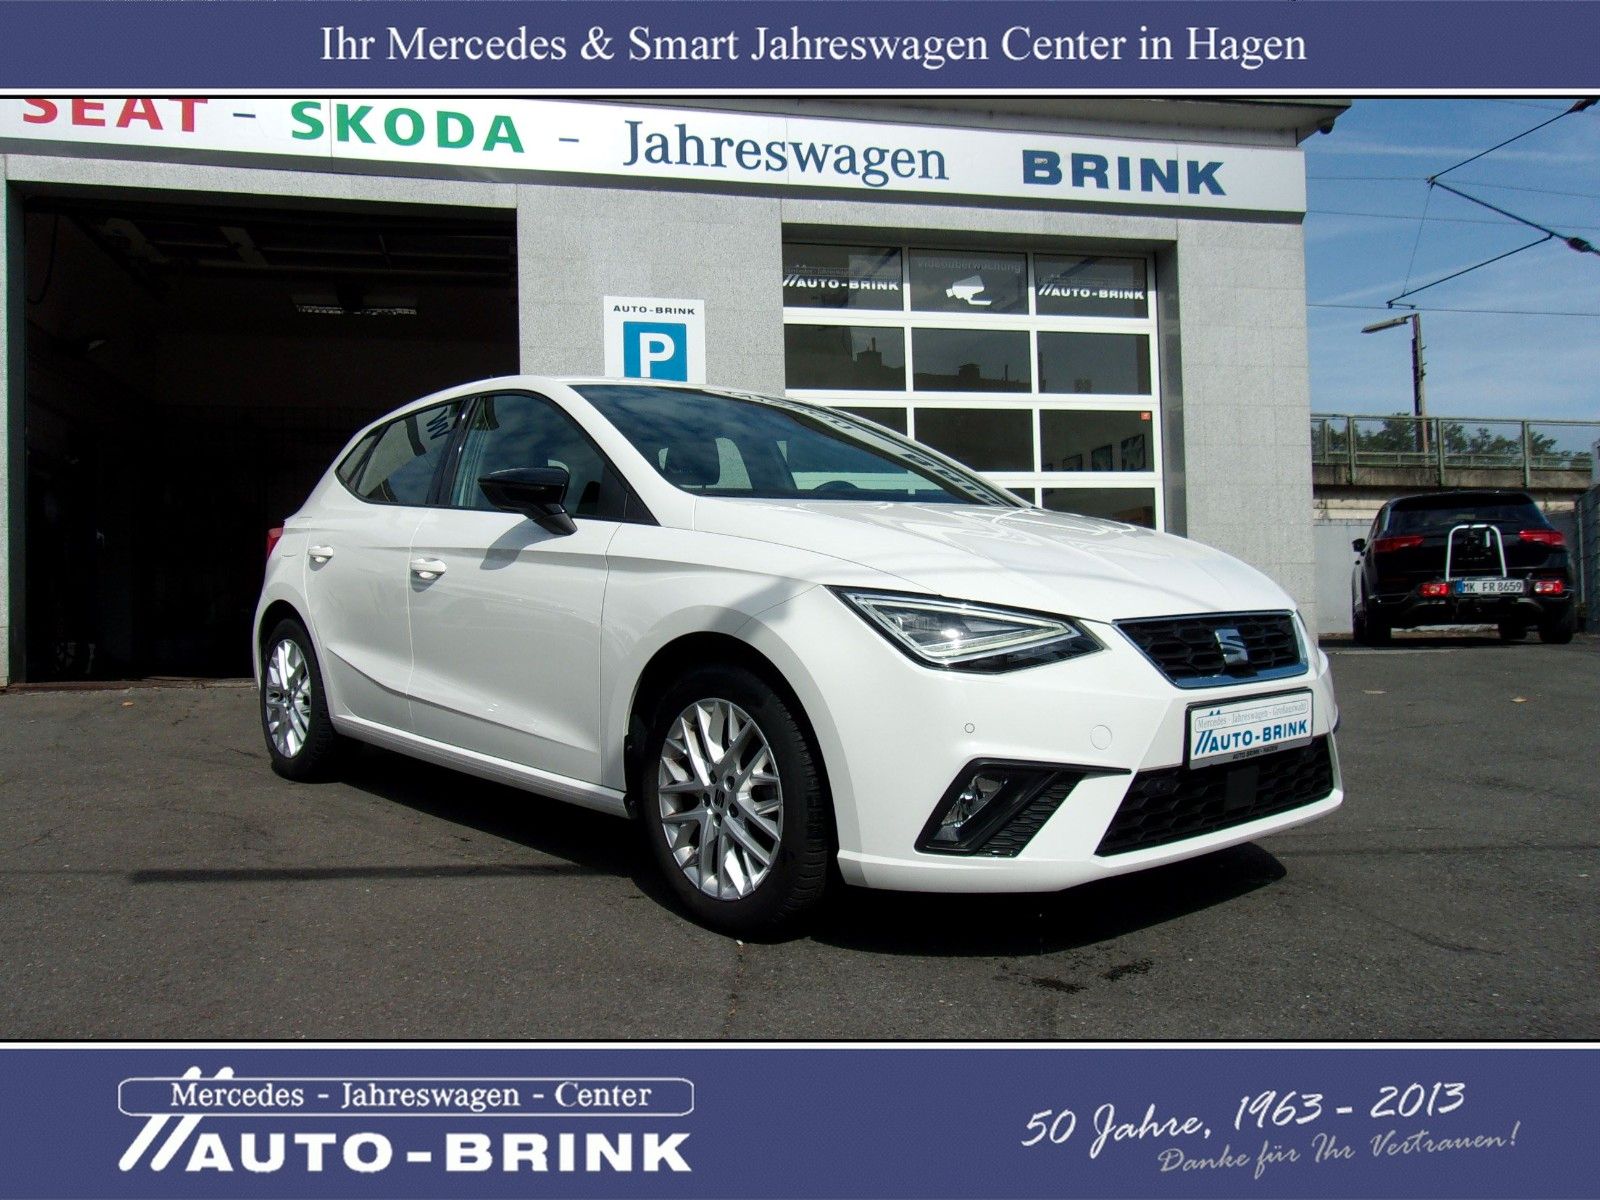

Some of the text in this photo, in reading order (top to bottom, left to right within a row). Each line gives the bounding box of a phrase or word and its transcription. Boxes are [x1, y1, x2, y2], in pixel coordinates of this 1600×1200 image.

[22, 97, 209, 133] SEAT
[290, 101, 525, 153] SKODA
[622, 120, 949, 187] Jahreswagen
[1022, 148, 1227, 196] BRINK
[613, 305, 696, 315] AUTO-BRINK
[639, 332, 675, 378] P
[1482, 582, 1495, 592] FR
[1497, 582, 1521, 591] 8659
